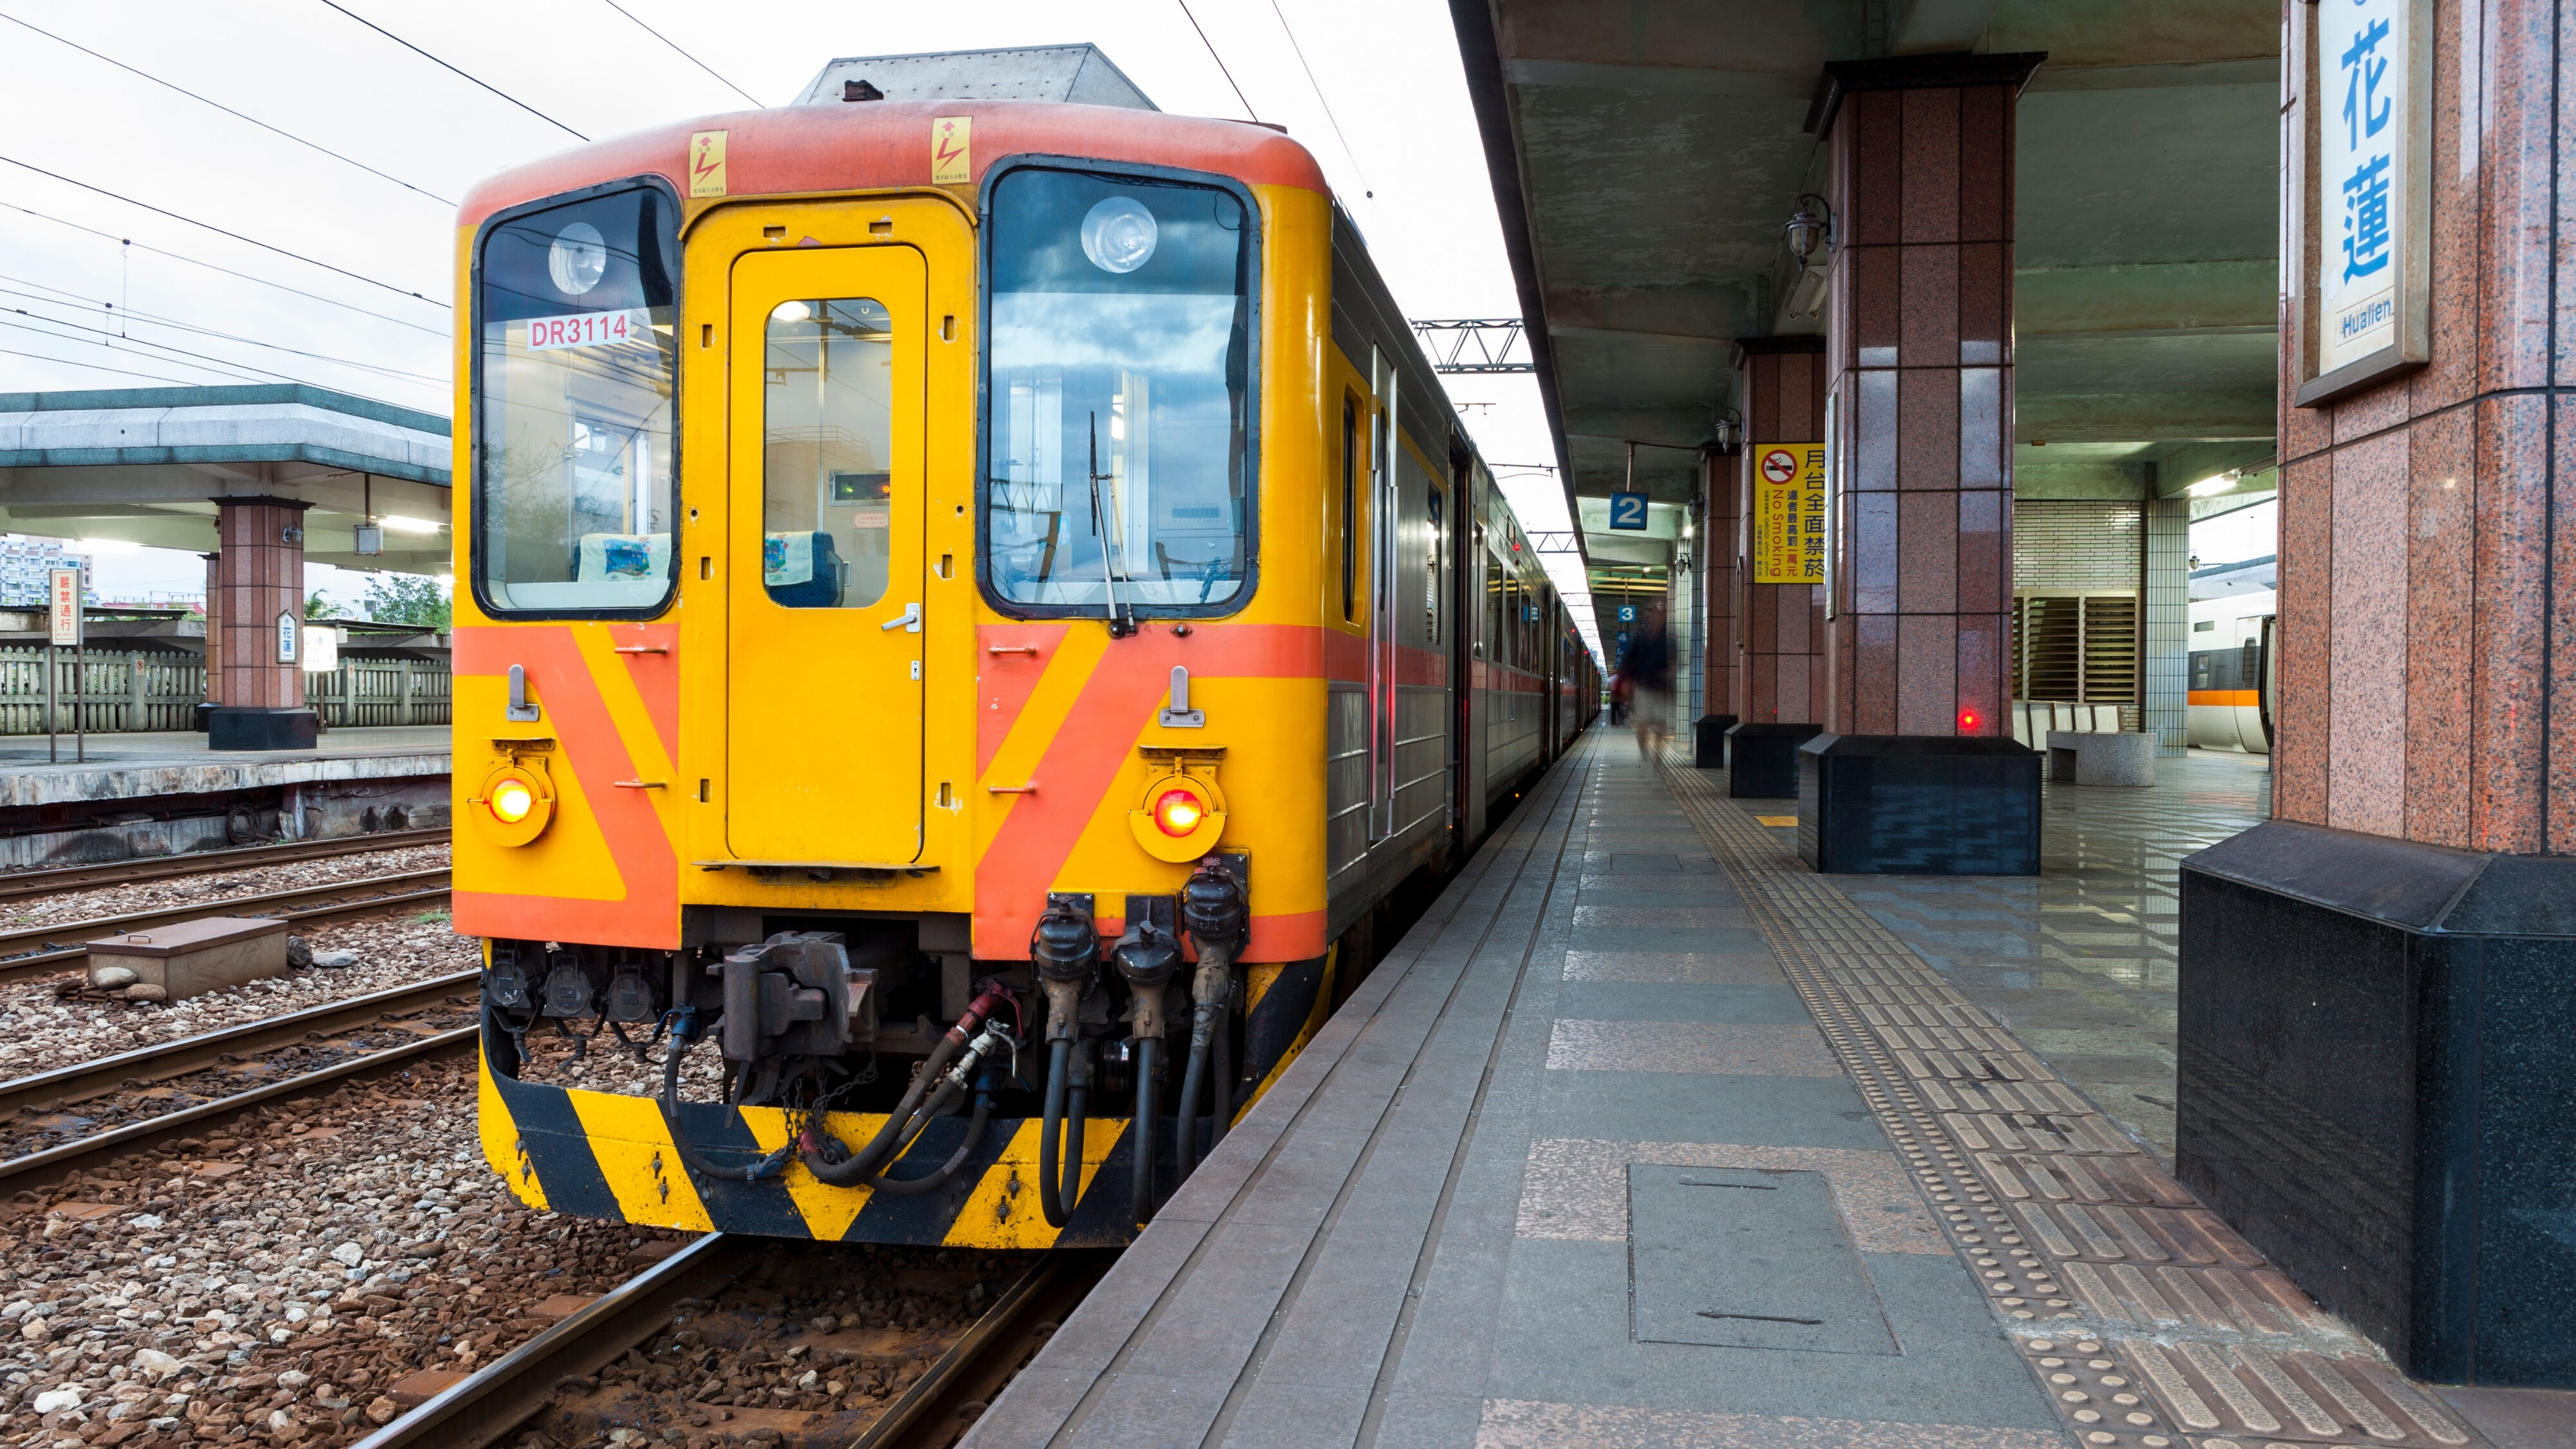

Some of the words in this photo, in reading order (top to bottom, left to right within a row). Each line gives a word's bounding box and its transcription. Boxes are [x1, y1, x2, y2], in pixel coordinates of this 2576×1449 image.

[2342, 17, 2391, 287] 花蓮
[533, 314, 627, 346] DR3114
[2343, 299, 2391, 339] Hualien
[1617, 497, 1642, 524] 2
[1772, 489, 1784, 509] No
[1804, 449, 1826, 577] 月台全面禁菸
[1770, 513, 1784, 576] Smoking
[60, 576, 71, 631] 嚴禁通行
[1622, 607, 1633, 620] 3
[283, 626, 292, 652] 花蓮
[1618, 633, 1627, 642] 4
